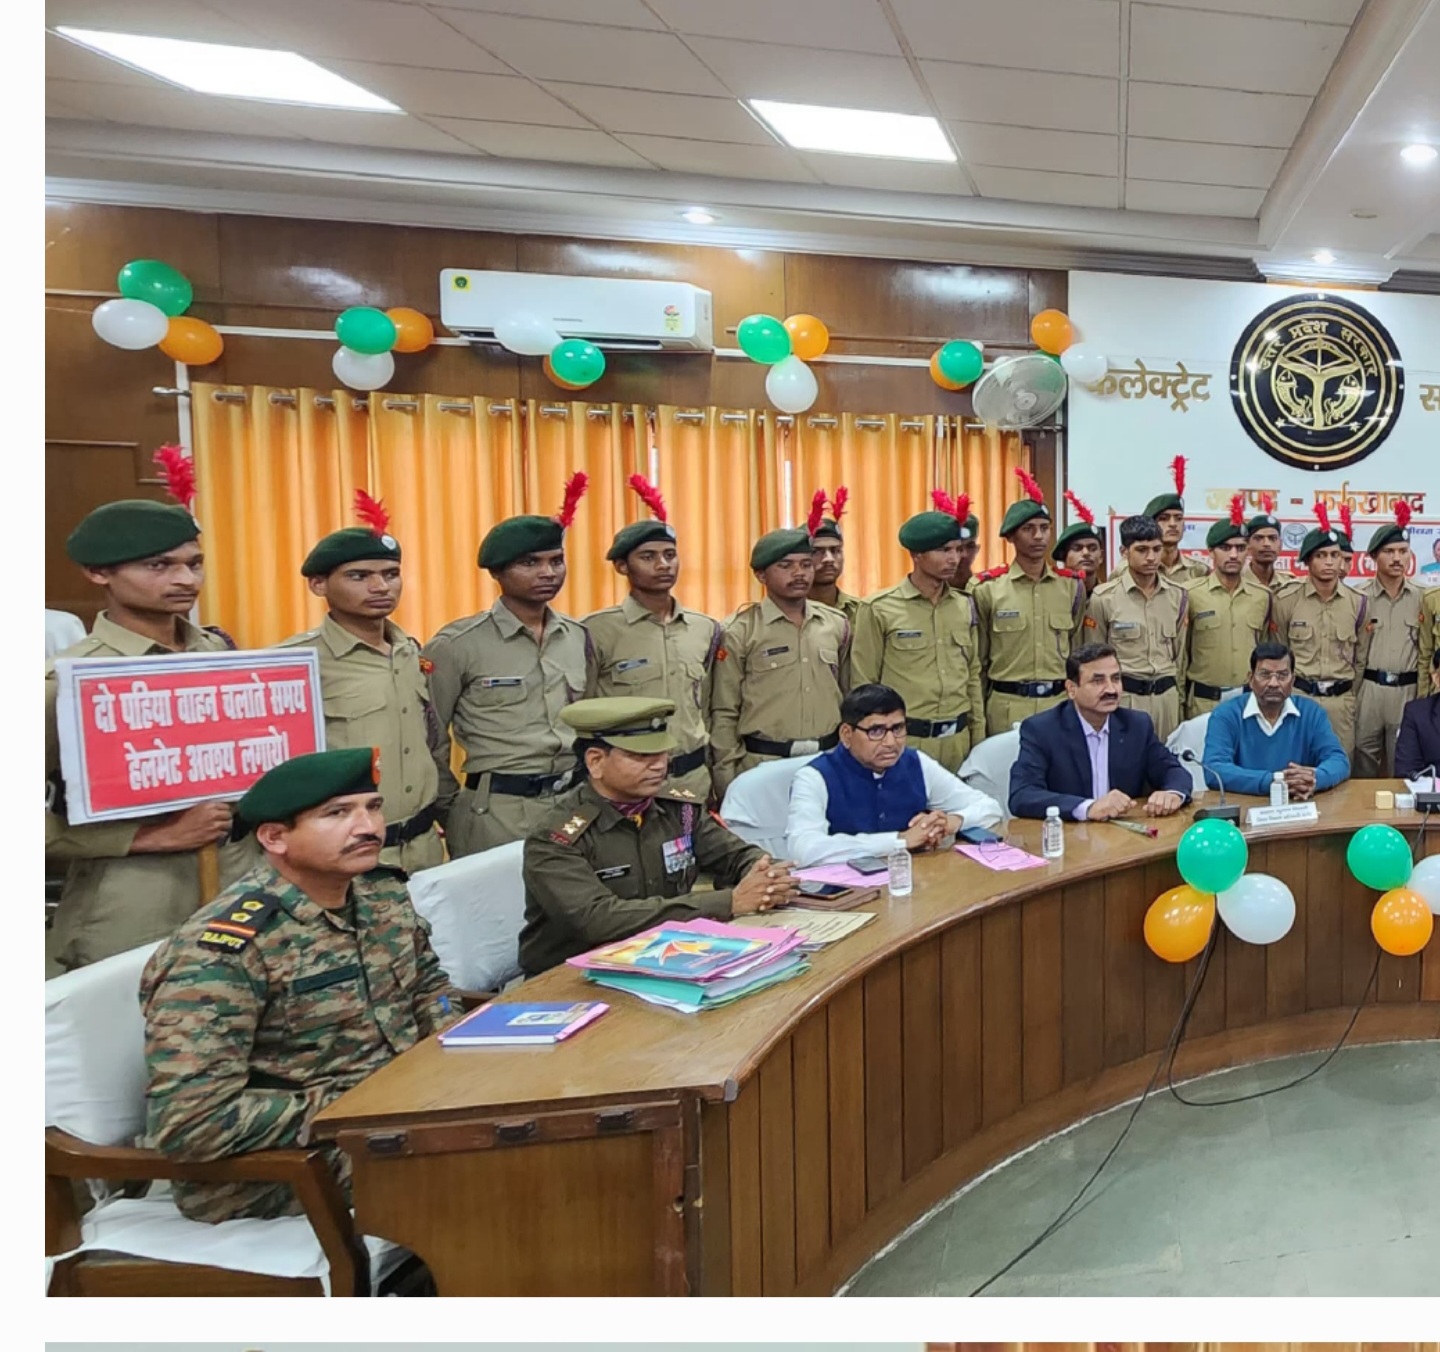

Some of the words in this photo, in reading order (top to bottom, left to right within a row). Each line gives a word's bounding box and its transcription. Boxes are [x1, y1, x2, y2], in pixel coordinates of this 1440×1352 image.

[92, 683, 117, 732] दो
[119, 681, 173, 730] पहिया
[174, 686, 219, 723] वाहन
[220, 672, 267, 719] चलाते
[268, 680, 307, 716] समय
[123, 737, 183, 790] हेलमेट
[186, 741, 237, 782] अवश्य
